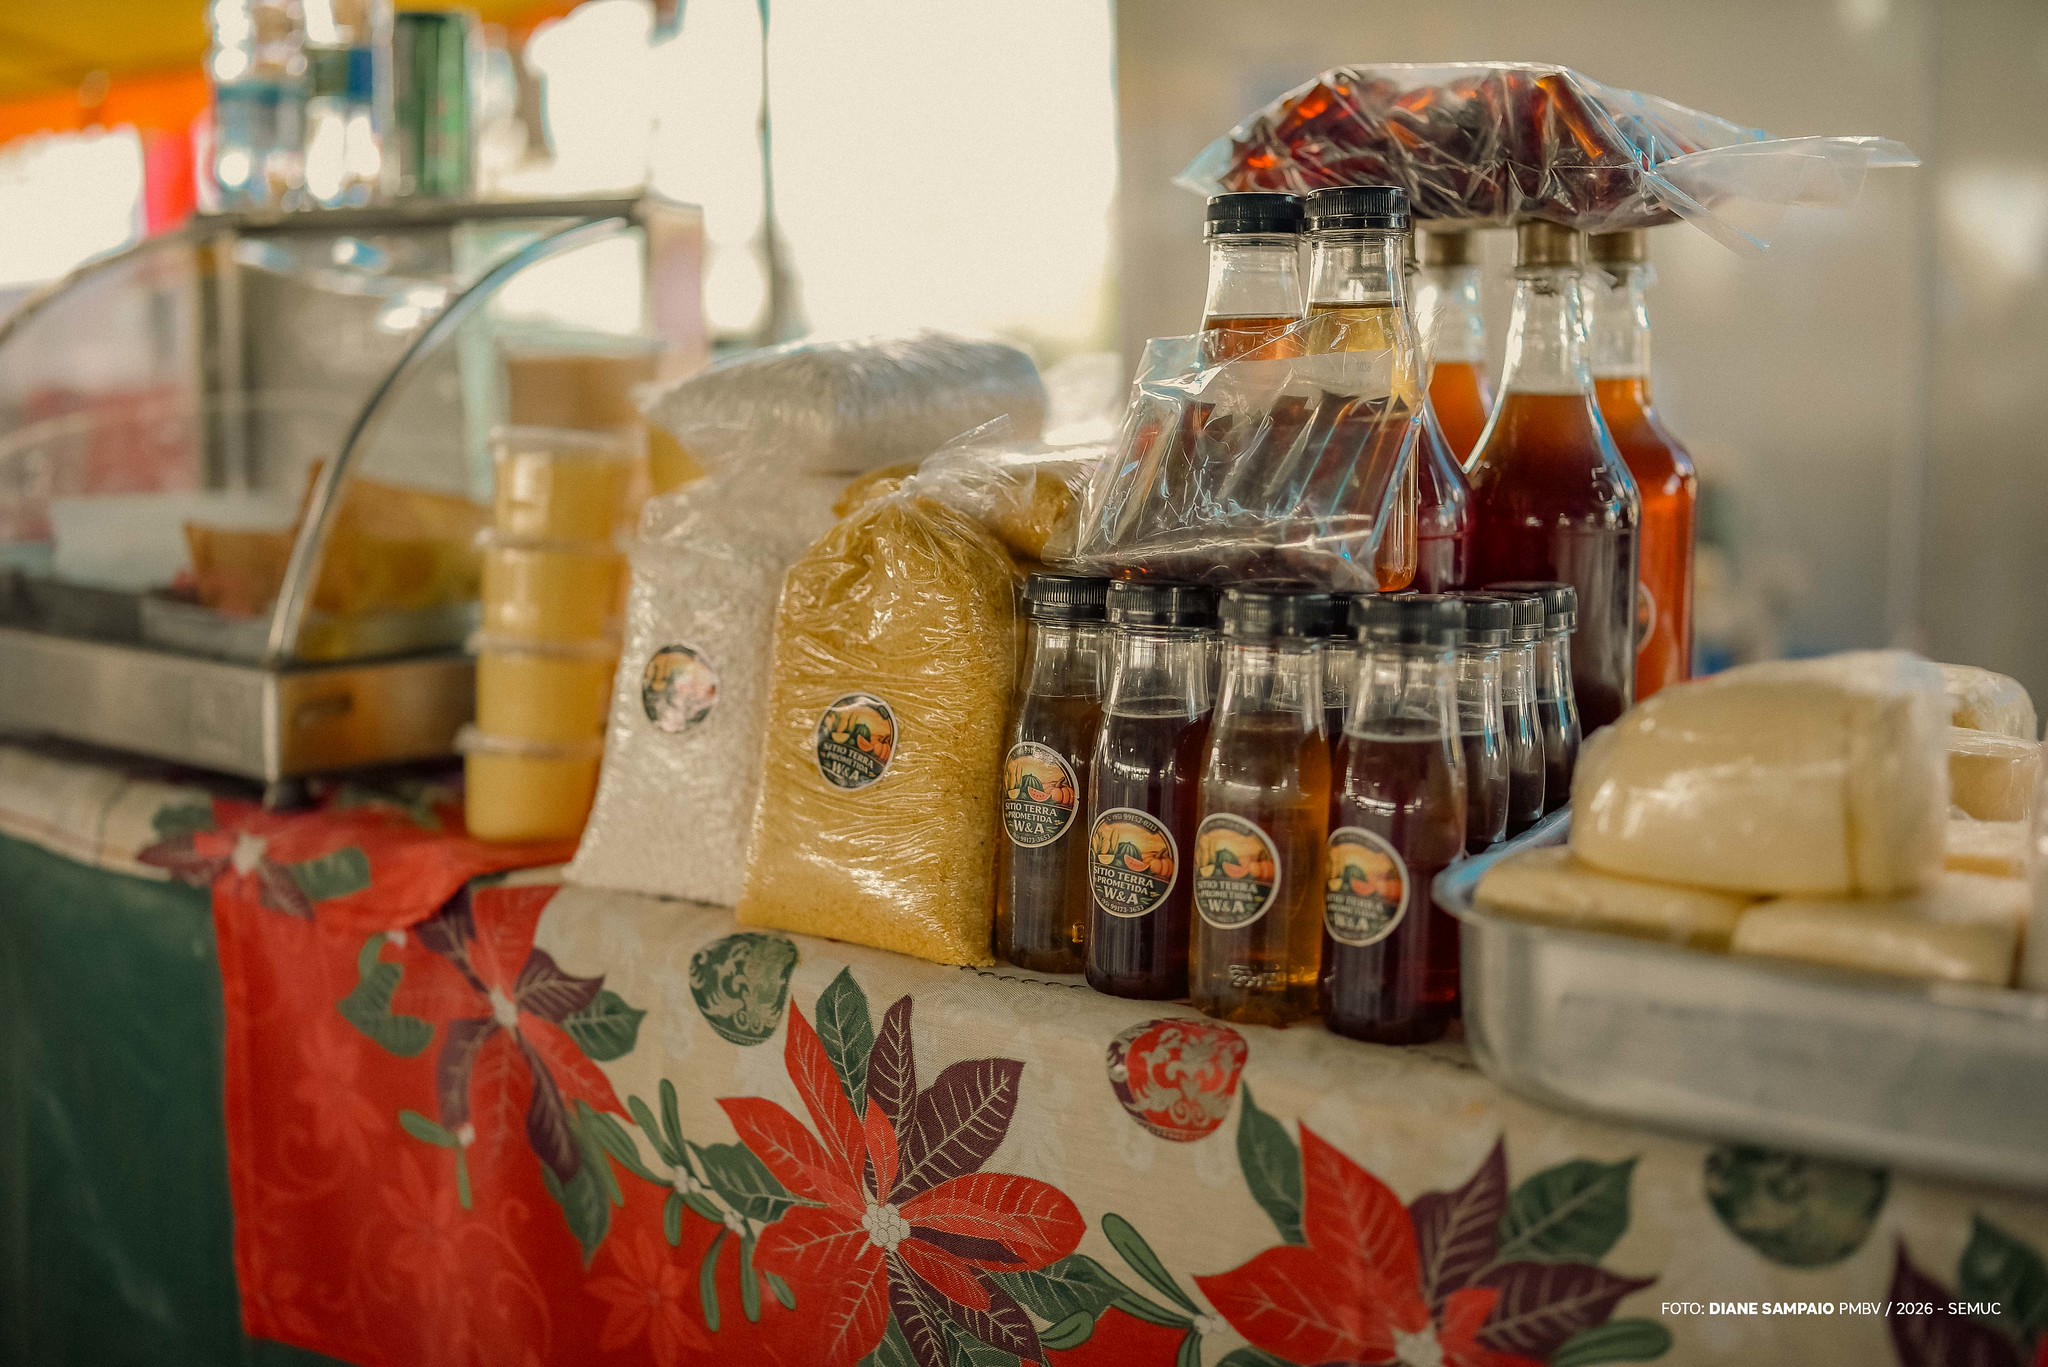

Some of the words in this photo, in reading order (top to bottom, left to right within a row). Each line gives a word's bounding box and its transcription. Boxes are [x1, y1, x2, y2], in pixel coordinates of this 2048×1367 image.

[848, 749, 874, 769] TERRA
[832, 761, 859, 780] W&A
[1008, 812, 1052, 823] PROMETIDA
[1024, 804, 1057, 817] TERRA
[1013, 820, 1045, 834] W&A
[1097, 876, 1148, 895] PROMETIDA
[1118, 872, 1154, 888] TERRA
[1220, 881, 1258, 893] TERRA
[1104, 886, 1138, 904] W&A
[1208, 899, 1245, 913] W&A
